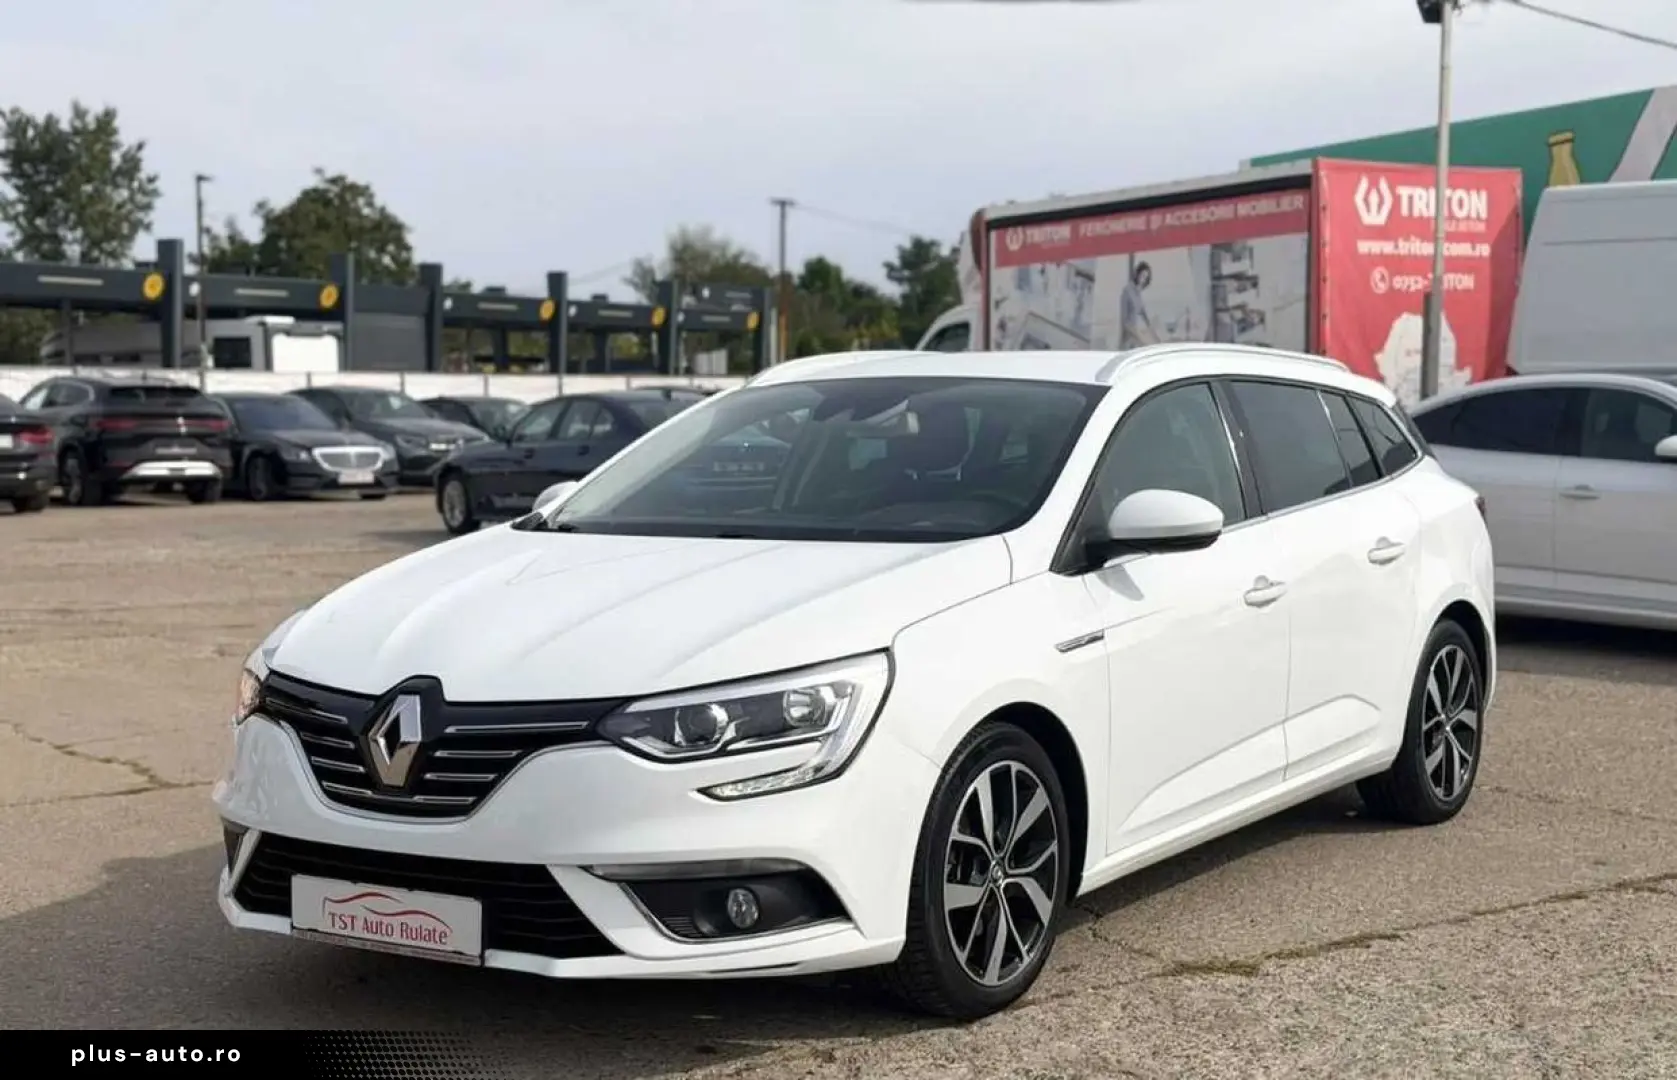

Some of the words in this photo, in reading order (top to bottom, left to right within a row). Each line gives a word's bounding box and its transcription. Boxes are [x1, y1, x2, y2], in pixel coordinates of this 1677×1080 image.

[1357, 235, 1491, 258] www.tritoncom.ro
[328, 911, 356, 931] TST
[362, 916, 394, 937] Auto
[400, 921, 448, 945] Rulate
